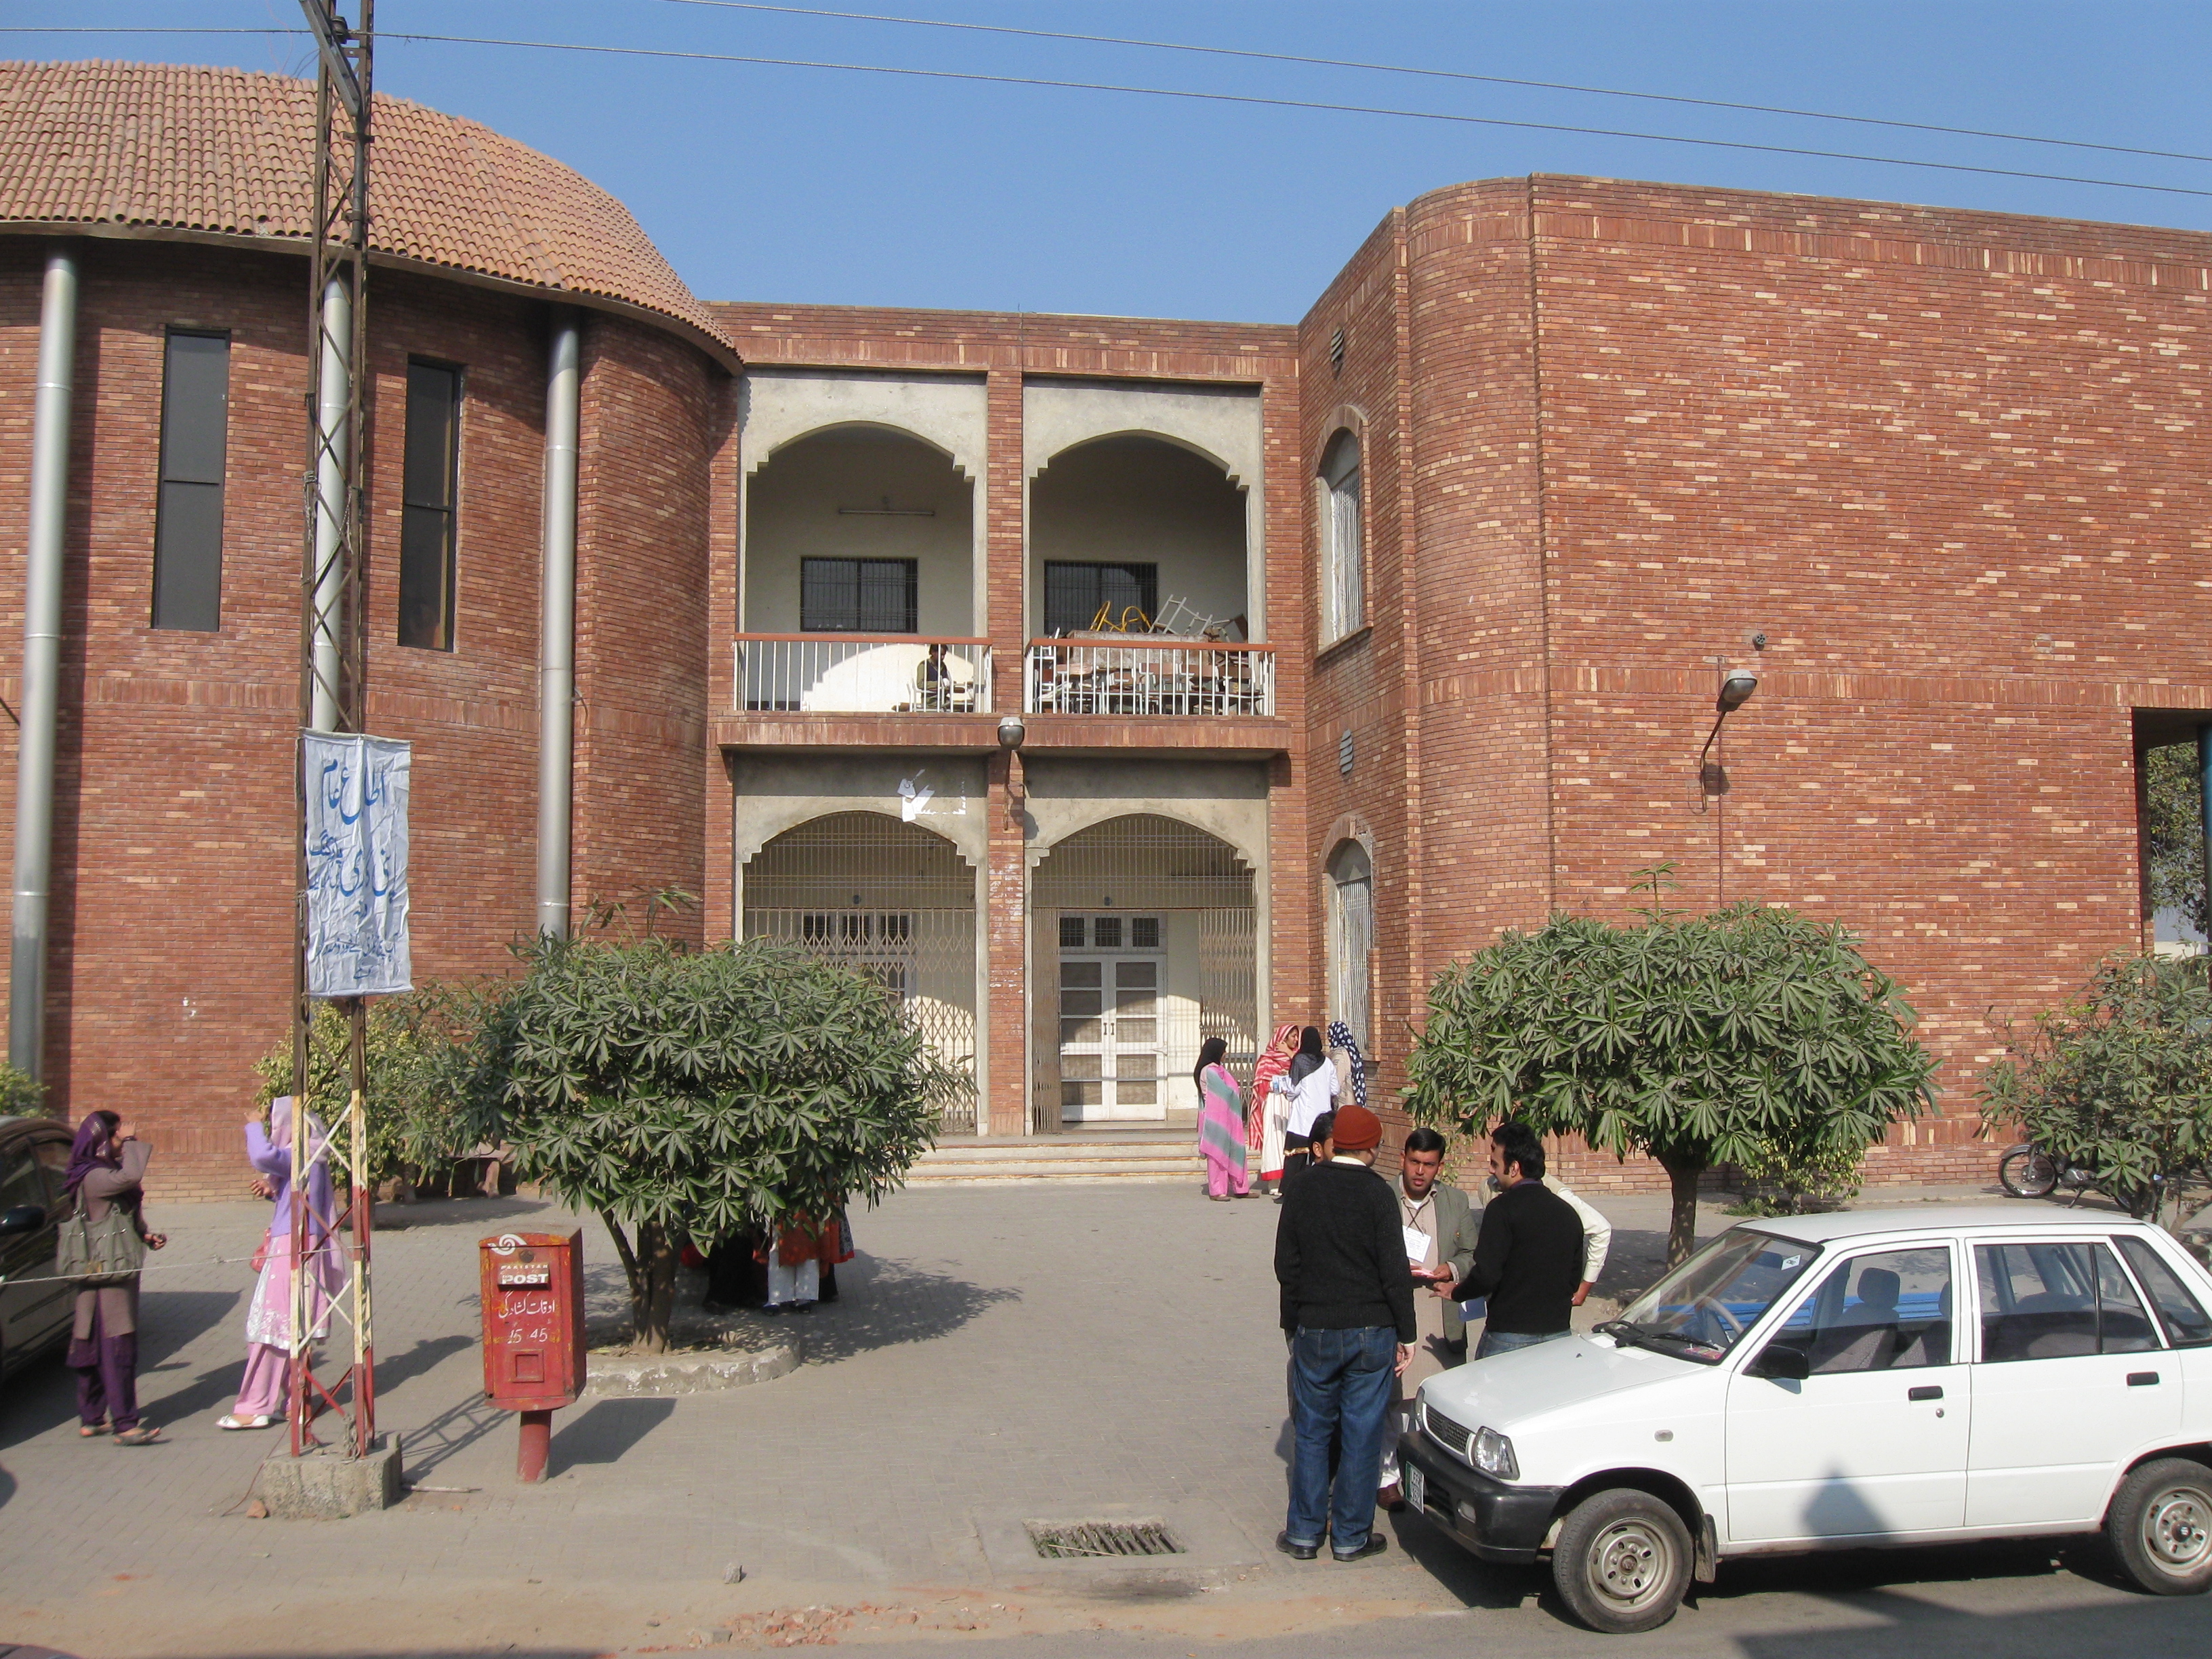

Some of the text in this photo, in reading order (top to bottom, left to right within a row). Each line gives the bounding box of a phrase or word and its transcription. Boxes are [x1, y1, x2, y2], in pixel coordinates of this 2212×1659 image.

[321, 758, 385, 828] اطلع عام
[501, 1273, 549, 1284] POST
[498, 1290, 555, 1318] اوقات کشادگی
[530, 1328, 548, 1343] 45
